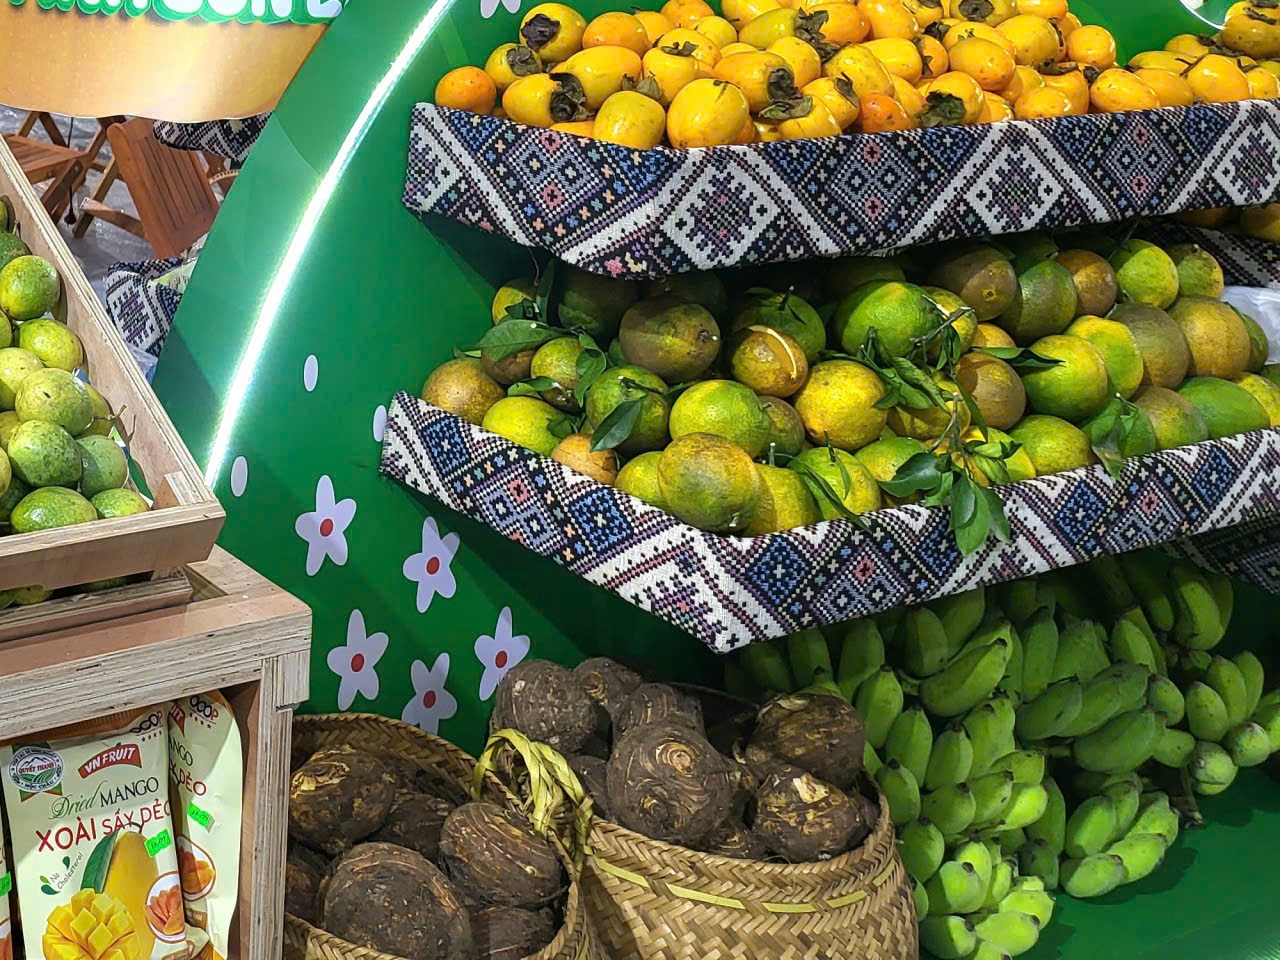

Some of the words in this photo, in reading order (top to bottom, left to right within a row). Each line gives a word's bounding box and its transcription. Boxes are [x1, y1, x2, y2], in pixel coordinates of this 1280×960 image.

[189, 695, 219, 721] OCOP
[84, 755, 100, 773] VN
[102, 747, 135, 766] FRUIT
[48, 780, 107, 819] Dried
[100, 776, 159, 808] MANGO
[179, 767, 207, 796] DẺO
[35, 816, 97, 852] XOÀI
[102, 809, 134, 836] SẤY
[57, 852, 84, 890] Cholesterol
